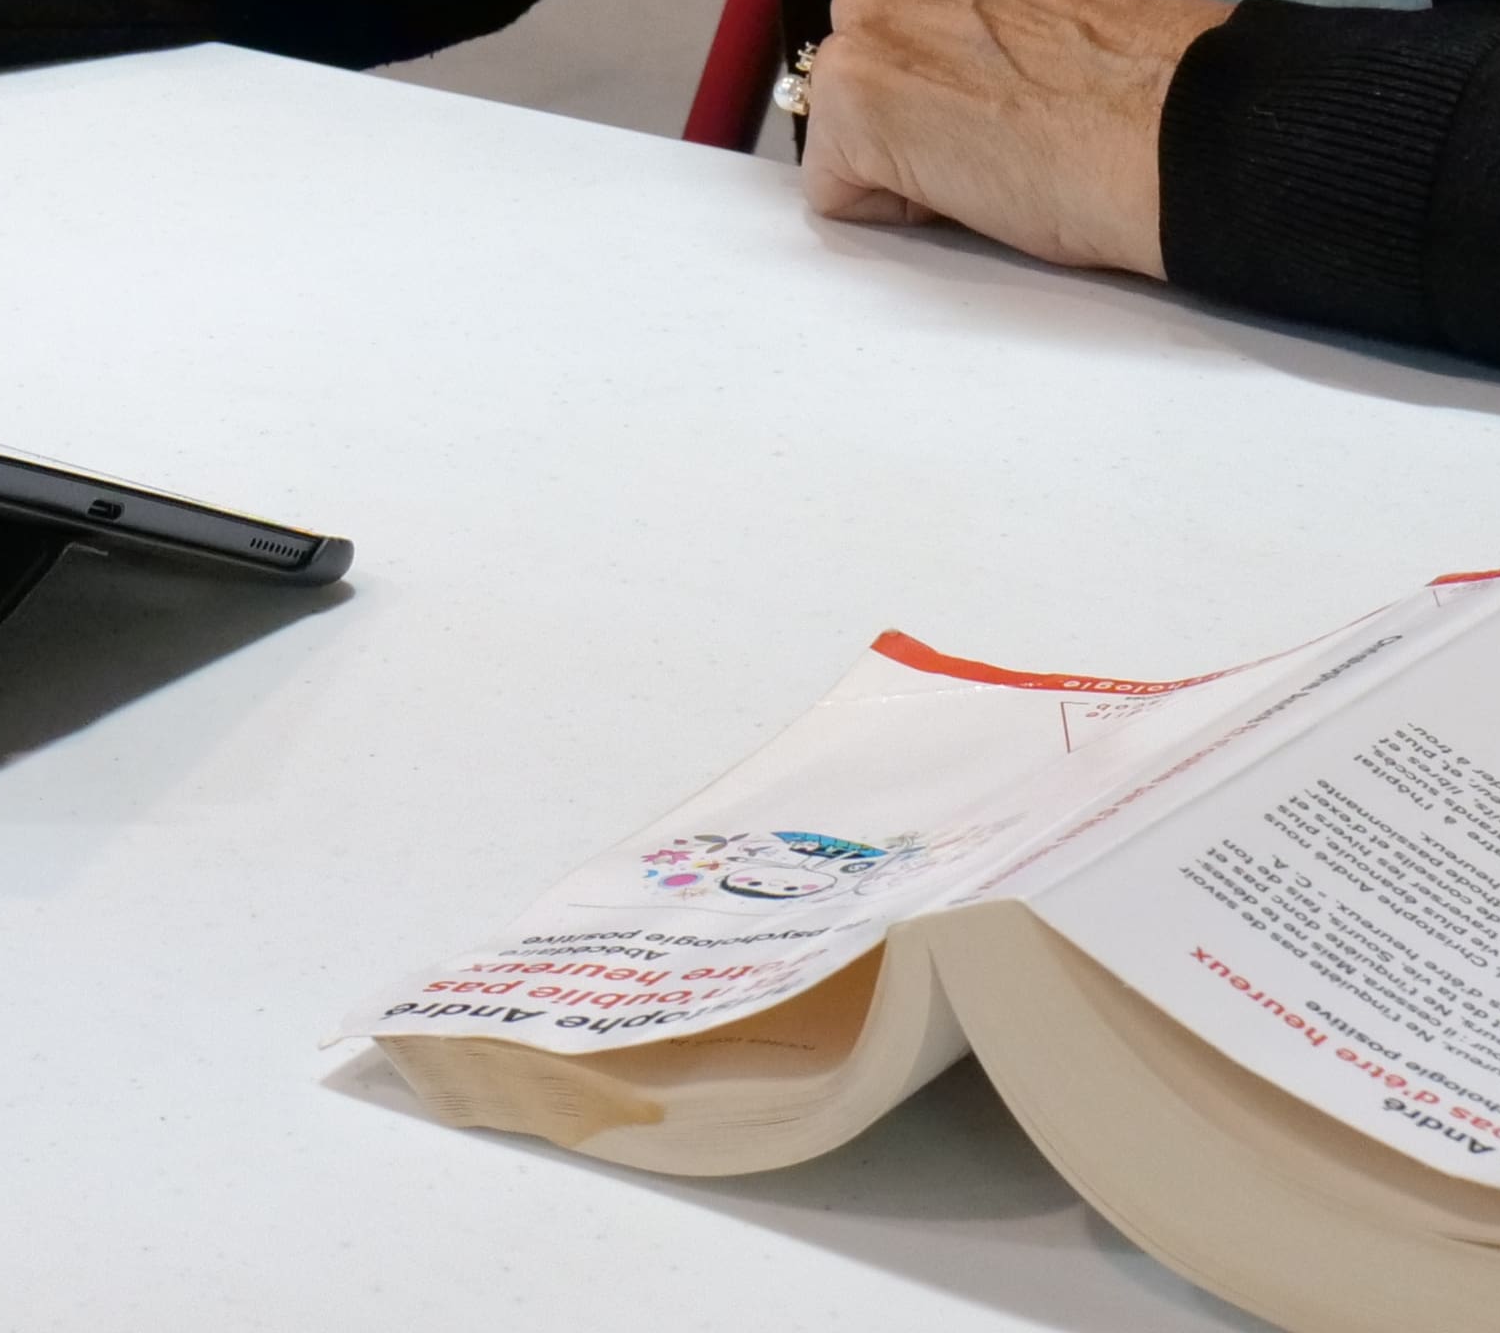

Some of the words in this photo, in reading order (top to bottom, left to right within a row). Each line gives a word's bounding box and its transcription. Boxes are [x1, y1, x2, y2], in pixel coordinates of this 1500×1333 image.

[1378, 737, 1402, 753] et
[1394, 729, 1438, 760] plus
[1407, 722, 1453, 755] trou-
[1407, 755, 1465, 795] libres
[1288, 795, 1310, 811] et
[1263, 812, 1313, 850] nous
[1276, 804, 1321, 836] plus
[1314, 812, 1373, 857] hivers
[1316, 779, 1445, 868] passionnante
[1368, 834, 1391, 850] et
[1314, 850, 1375, 893] André
[1376, 857, 1407, 881] les
[1392, 850, 1474, 905] conseils
[1409, 881, 1499, 940] traverser
[1421, 906, 1469, 936] plus
[521, 929, 643, 945] positive
[644, 927, 830, 949] psychologie
[1377, 894, 1489, 968] Christophe
[498, 945, 670, 961] Abécédaire
[1470, 937, 1500, 958] vie
[421, 980, 524, 997] pas
[457, 963, 672, 987] heureux
[1190, 946, 1329, 1048] heureux
[382, 1002, 546, 1024] André
[1305, 1000, 1403, 1061] positive
[1383, 1097, 1496, 1155] André
